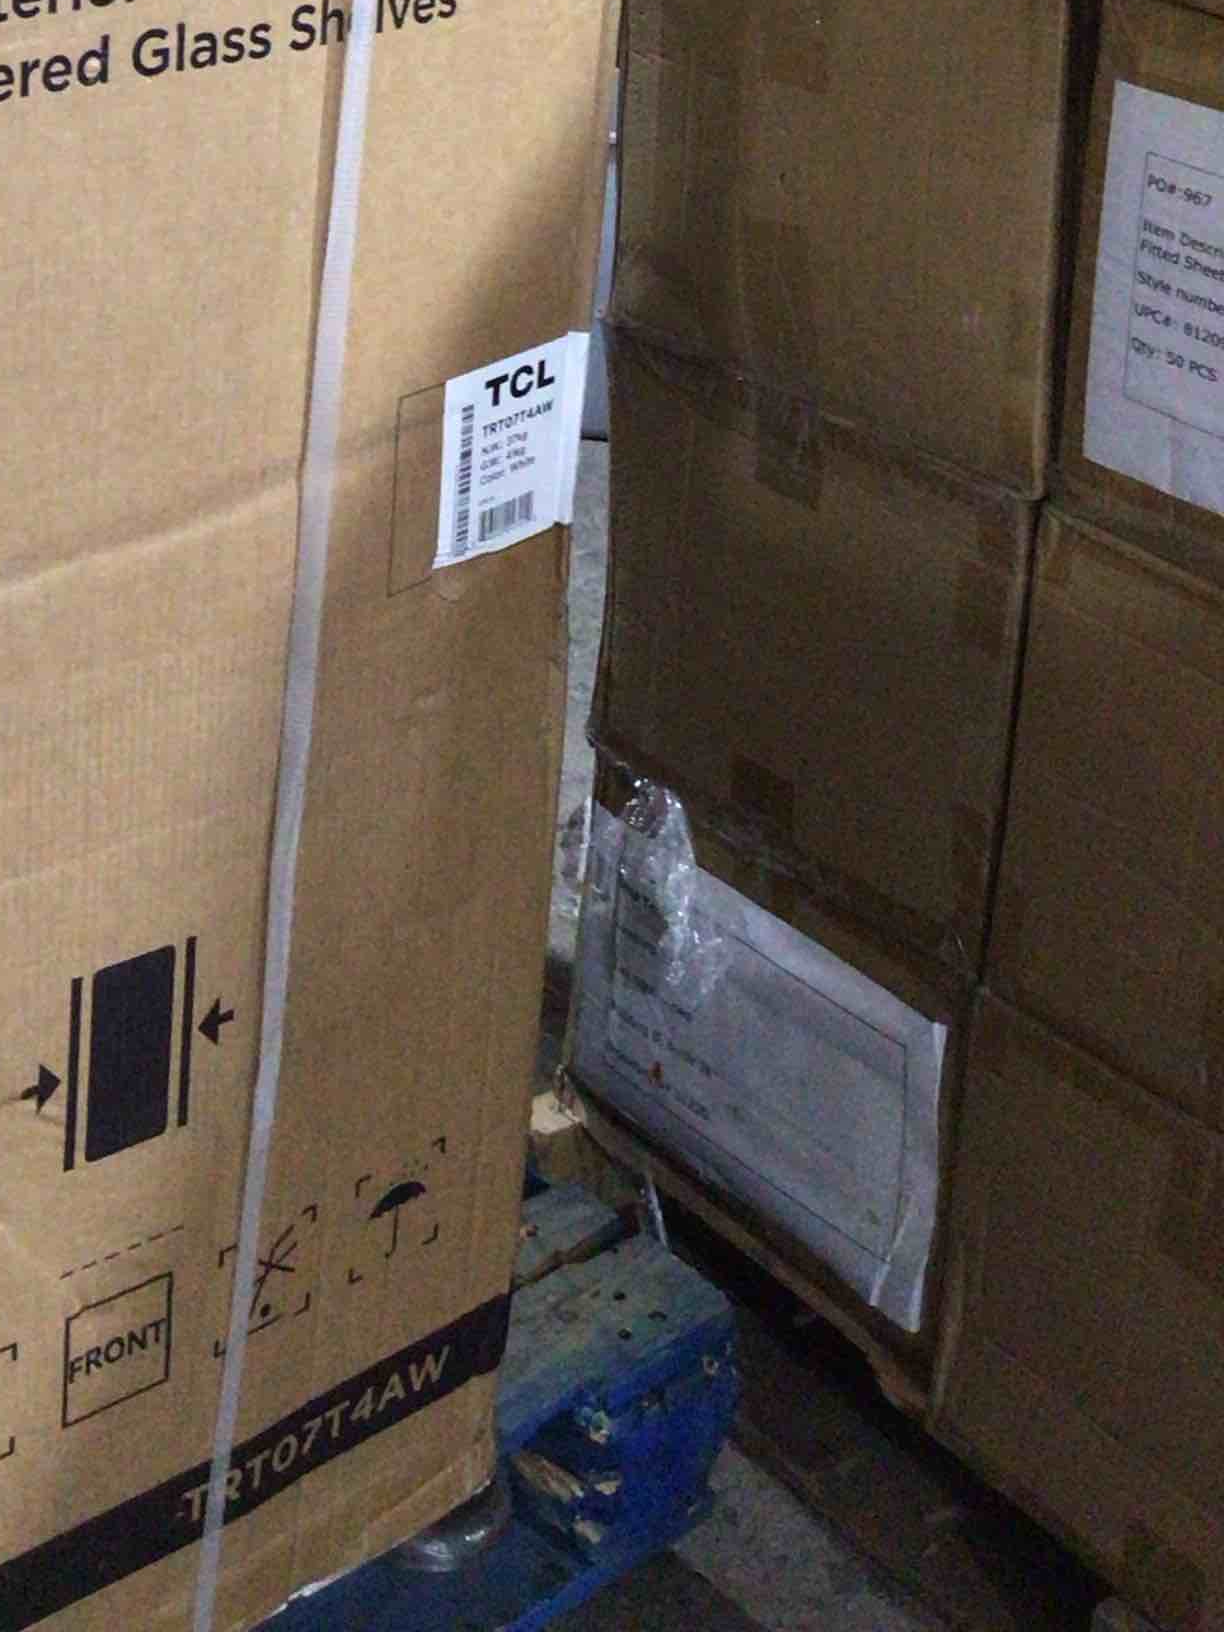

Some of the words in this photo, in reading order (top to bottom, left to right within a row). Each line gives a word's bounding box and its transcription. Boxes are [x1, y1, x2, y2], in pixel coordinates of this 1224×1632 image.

[131, 19, 273, 78] Glass
[484, 360, 556, 407] TCL
[1189, 360, 1219, 383] PCS
[69, 1317, 167, 1385] FRONT
